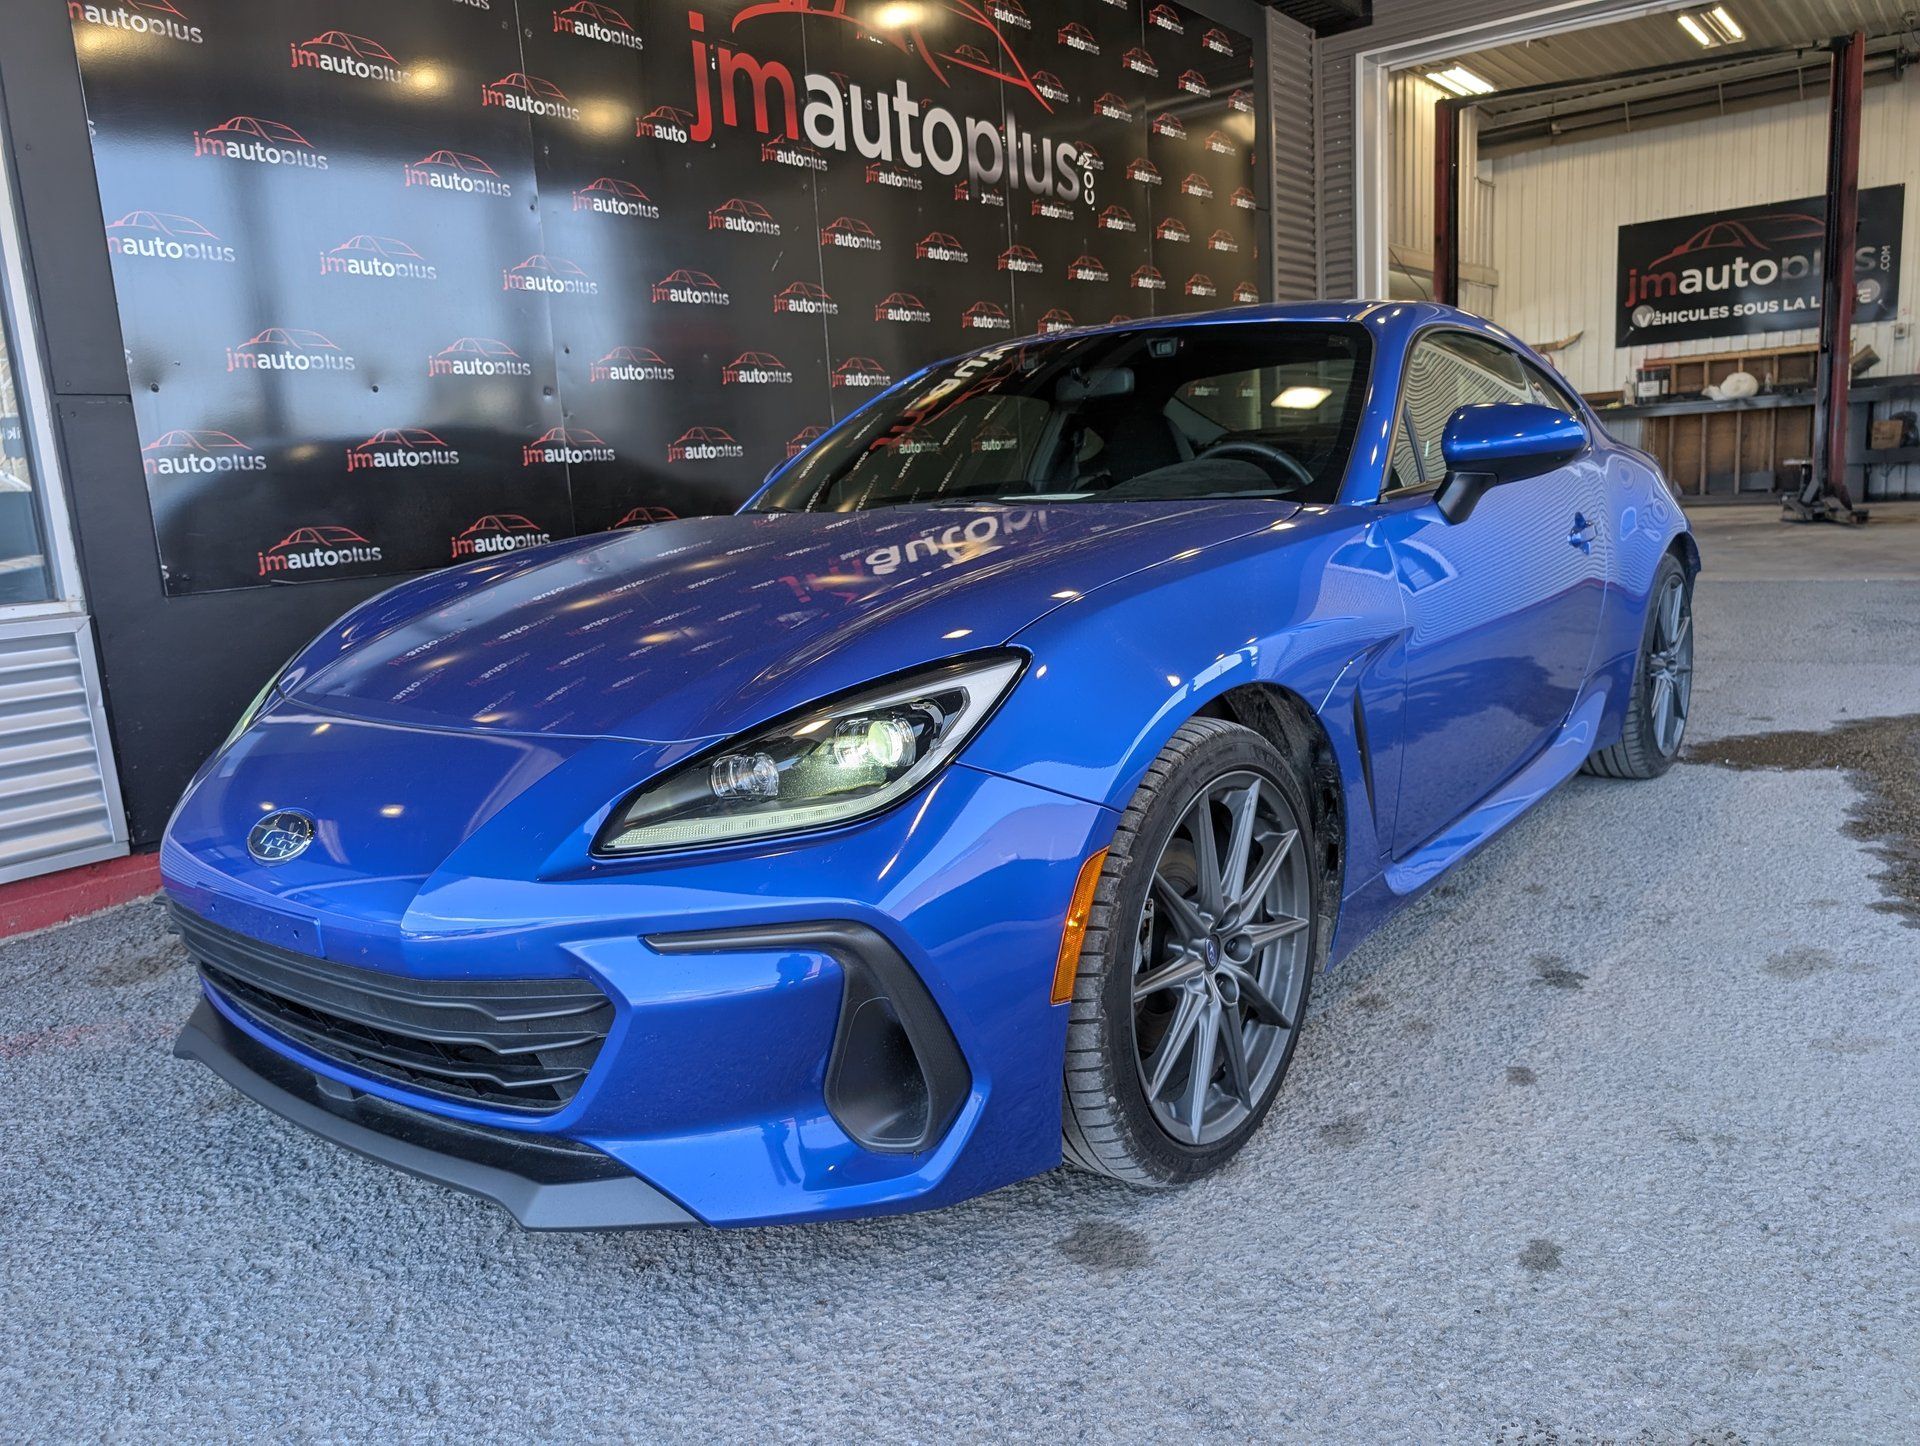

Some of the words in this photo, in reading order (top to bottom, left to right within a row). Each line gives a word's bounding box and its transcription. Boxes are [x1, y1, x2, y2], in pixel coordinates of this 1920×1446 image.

[69, 1, 203, 43] mautoplus
[553, 11, 643, 50] jmautoplus
[482, 84, 580, 121] jmautoplus
[688, 10, 1080, 201] jmautoplus
[635, 117, 687, 144] jmauto
[193, 131, 328, 170] jmautoplus
[761, 144, 828, 171] jmautoplus
[404, 164, 511, 197] jmautoplus
[865, 165, 923, 191] jmautoplus
[572, 191, 659, 219] jmautoplus
[708, 211, 780, 236] jmautoplus
[107, 235, 235, 262] mautoplus
[821, 227, 881, 251] jmautoplus
[915, 243, 968, 263] jmautoplus
[320, 252, 437, 280] jmautoplus
[1625, 246, 1876, 307] jmautopls
[503, 270, 597, 294] jmautoplus
[652, 285, 729, 305] jmautoplus
[773, 294, 838, 315] jmautoplus
[1733, 301, 1778, 316] SOUS
[1784, 297, 1805, 311] LA
[874, 305, 931, 323] jmautoplus
[226, 348, 355, 372] jmautoplus
[428, 355, 531, 377] jmautoplus
[590, 363, 675, 382] jmautoplus
[722, 366, 793, 385] jmautoplus
[831, 370, 891, 387] jmautoplus
[143, 453, 267, 474] mautoplus
[347, 449, 459, 472] jmautoplus
[523, 446, 615, 466] jmautoplus
[667, 443, 743, 463] jmautoplus
[451, 532, 550, 559] jmautoplus
[258, 545, 382, 576] jmautoplus
